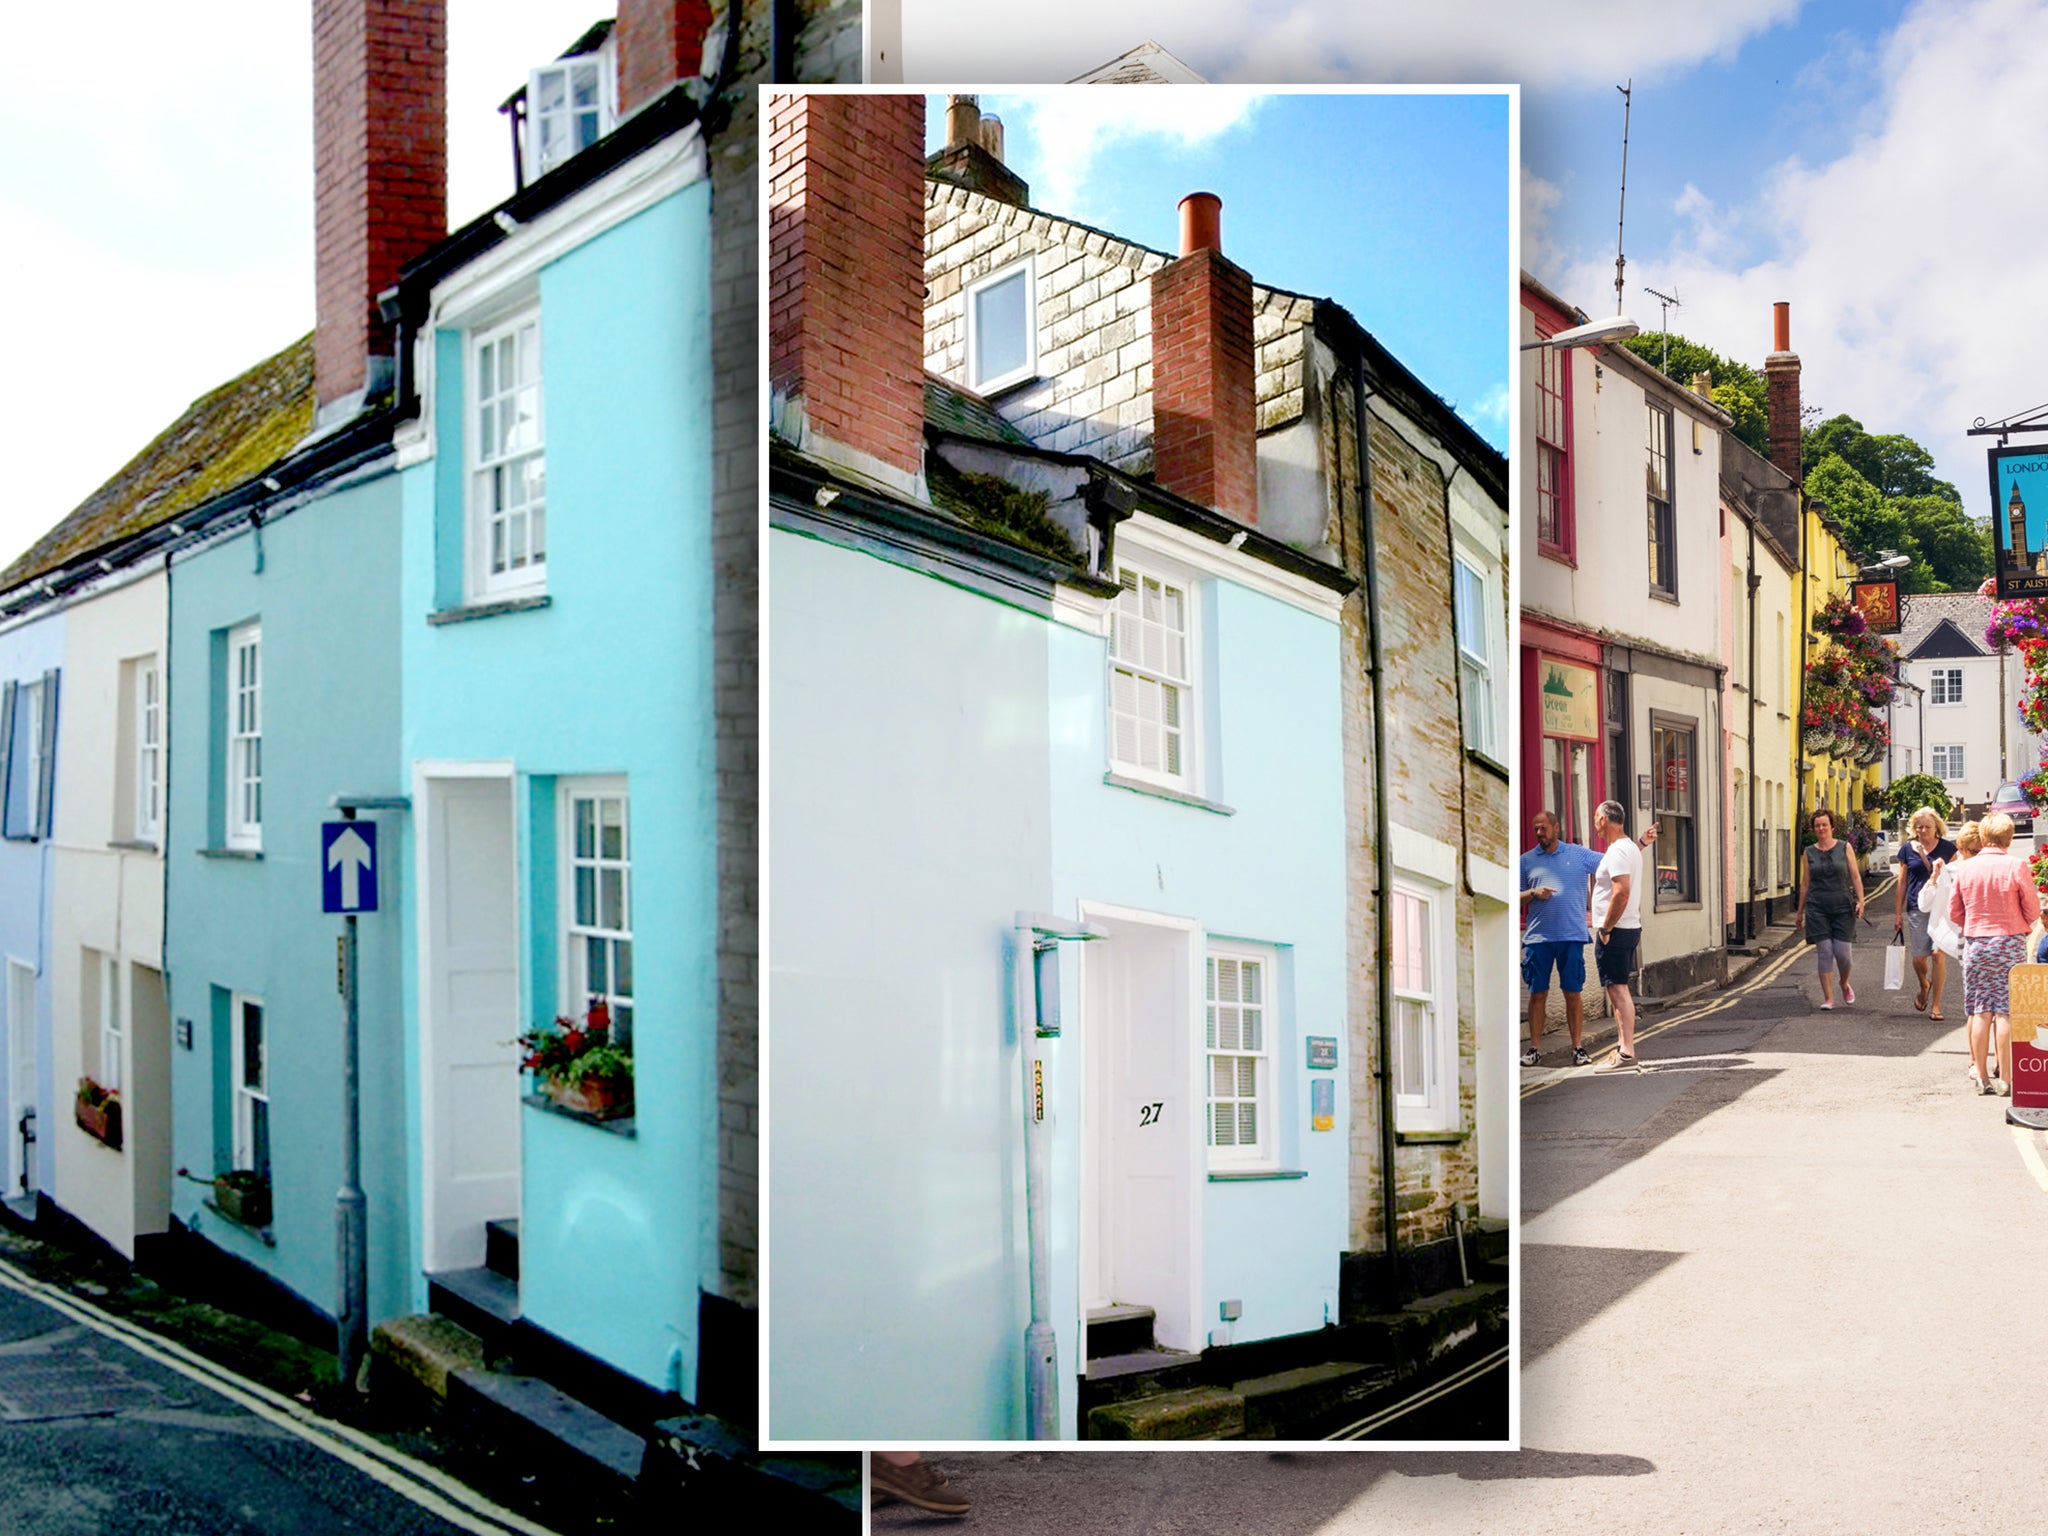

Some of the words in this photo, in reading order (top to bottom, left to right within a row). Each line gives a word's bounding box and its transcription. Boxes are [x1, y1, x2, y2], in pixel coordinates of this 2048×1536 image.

[2006, 461, 2048, 474] LONDO
[2008, 579, 2021, 590] ST
[1544, 694, 1568, 713] Ocean
[1139, 1102, 1164, 1127] 27
